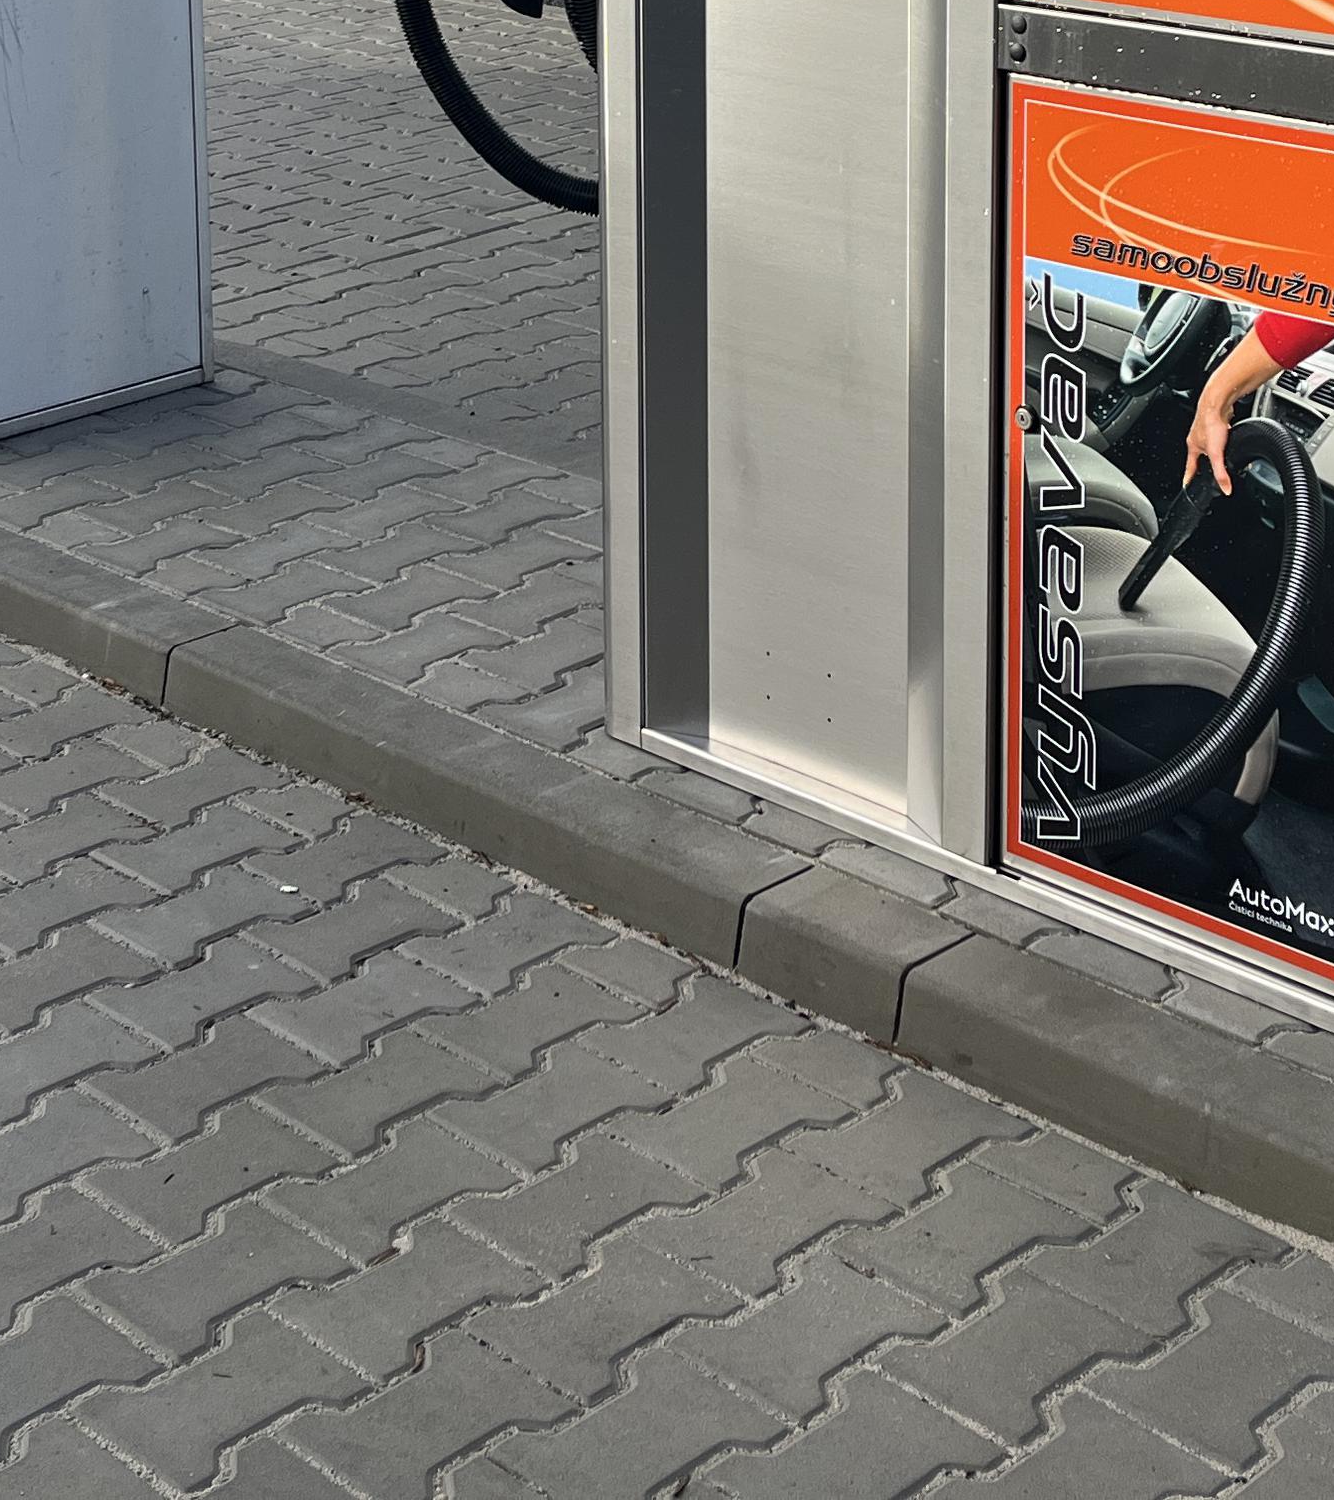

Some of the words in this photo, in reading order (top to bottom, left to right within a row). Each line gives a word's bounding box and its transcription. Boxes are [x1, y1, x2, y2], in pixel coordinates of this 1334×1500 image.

[1028, 271, 1097, 841] vysavač
[1229, 878, 1334, 937] AutoMax
[1255, 911, 1293, 933] technika
